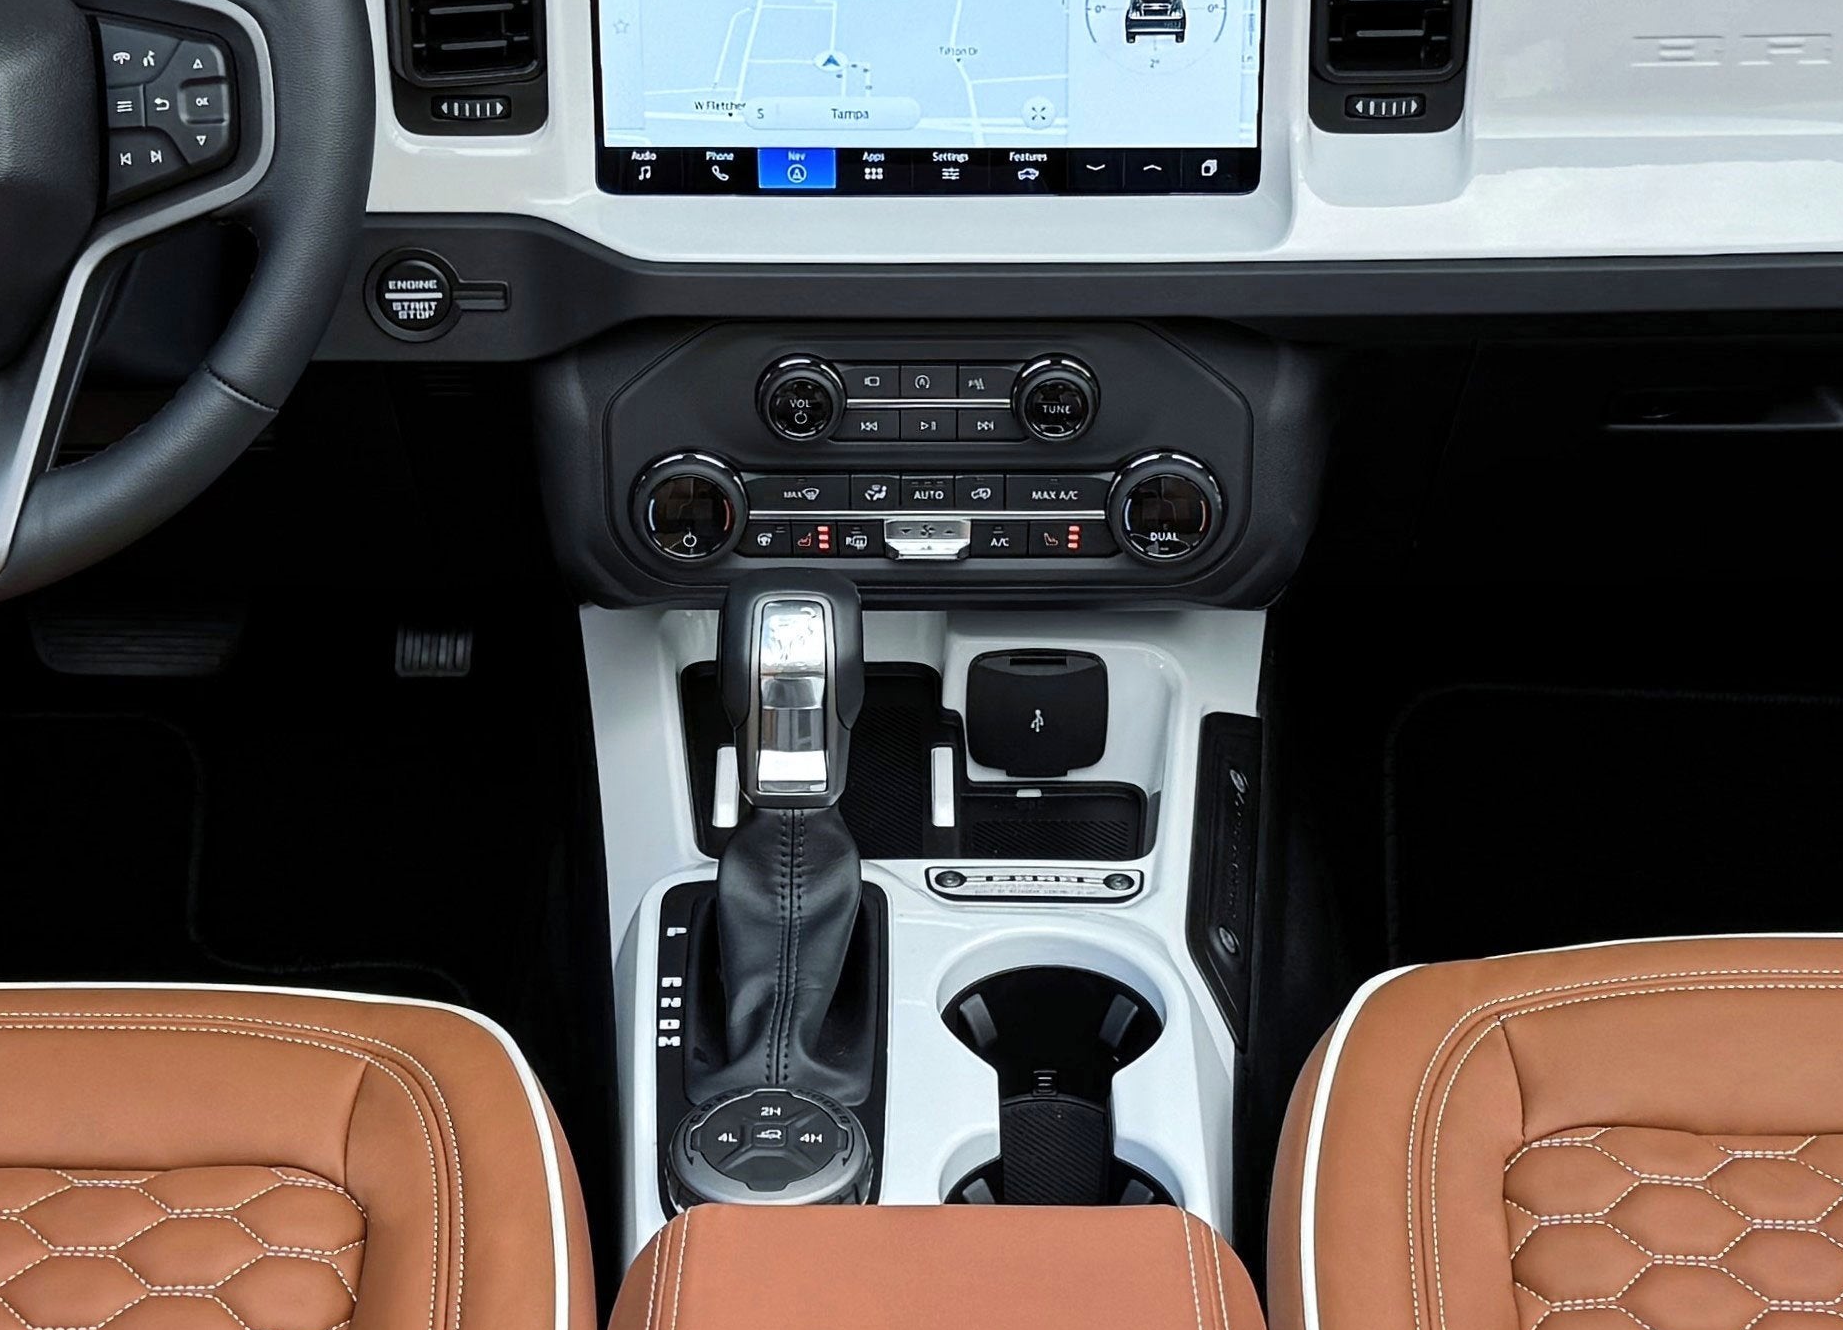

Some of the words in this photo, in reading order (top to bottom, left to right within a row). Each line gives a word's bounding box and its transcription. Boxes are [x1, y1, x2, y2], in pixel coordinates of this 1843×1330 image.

[196, 97, 209, 106] OK
[757, 109, 764, 119] S
[831, 109, 869, 120] Tampa
[631, 150, 657, 161] Audio
[706, 151, 734, 161] Phone
[788, 151, 805, 161] Nav
[862, 151, 885, 162] Apps
[932, 151, 969, 163] Settings
[1009, 151, 1047, 162] Features
[388, 280, 438, 289] ENGINE
[392, 302, 437, 311] START
[398, 310, 434, 320] STOP
[790, 399, 811, 408] VOL
[1042, 404, 1072, 414] TUNE
[914, 490, 944, 500] AUTO
[1032, 491, 1056, 500] MAX
[1059, 490, 1079, 500] A/C
[990, 537, 1009, 547] A/C
[1150, 532, 1179, 542] DUAL
[658, 1036, 681, 1047] M
[760, 1107, 781, 1116] 2H
[717, 1133, 738, 1142] 4L
[799, 1133, 823, 1143] 4H
